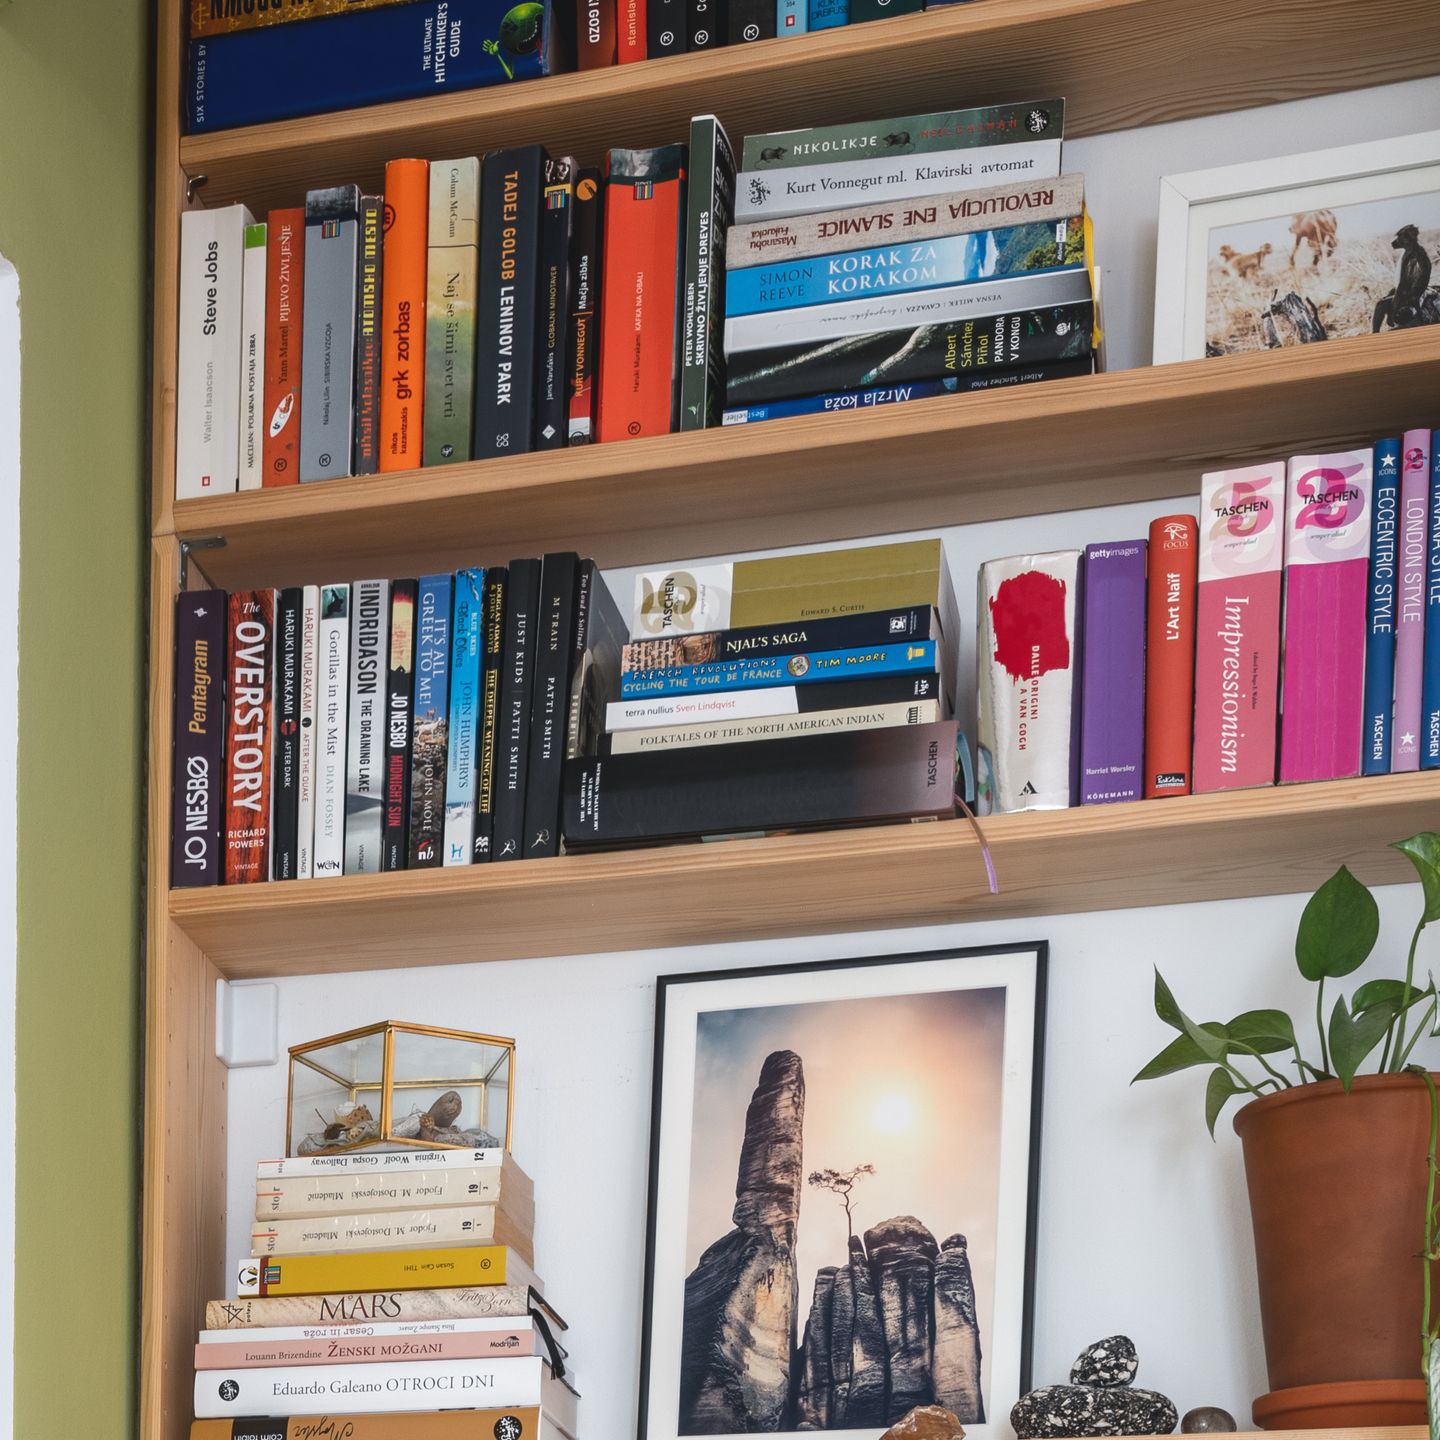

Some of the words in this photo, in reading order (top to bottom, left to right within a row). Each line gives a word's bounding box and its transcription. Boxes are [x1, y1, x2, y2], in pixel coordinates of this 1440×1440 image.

[198, 44, 207, 56] BY
[435, 1, 449, 83] HITCHHIKER'S
[449, 20, 461, 57] GUIDE
[196, 59, 206, 104] STORIES
[197, 107, 205, 123] SIX
[793, 136, 878, 155] NIKOLIKJE
[786, 180, 816, 195] Kurt
[818, 175, 883, 194] Vonnegut
[887, 172, 907, 184] ml.
[916, 164, 972, 181] Klavirski
[981, 158, 1034, 175] avtomat
[504, 171, 519, 222] TADEJ
[948, 190, 1054, 219] REVOLUCIJA
[818, 213, 893, 239] SLAMICE
[903, 210, 936, 226] ENE
[203, 241, 218, 286] Jobs
[501, 227, 516, 280] GOLOB
[828, 250, 902, 275] KORAK
[910, 246, 936, 261] ZA
[759, 266, 813, 286] SIMON
[828, 267, 938, 295] KORAKOM
[760, 285, 805, 302] REEVE
[203, 292, 217, 336] Steve
[499, 286, 515, 357] LENINOV
[393, 301, 411, 362] zorbas
[391, 369, 410, 399] grk
[497, 361, 511, 405] PARK
[1215, 500, 1269, 518] TASCHEN
[1302, 489, 1359, 506] TASCHEN
[1375, 487, 1395, 578] ECCENTRIC
[1090, 546, 1139, 559] gettyimages
[662, 577, 674, 628] TASCHEN
[1168, 572, 1181, 606] Naïf
[242, 601, 261, 615] The
[1373, 581, 1392, 634] STYLE
[285, 609, 295, 655] HARUKI
[1167, 610, 1181, 640] L'Art
[329, 630, 340, 680] Gorillas
[726, 637, 770, 652] NJAL'S
[773, 632, 808, 646] SAGA
[189, 640, 213, 734] Pentagram
[283, 658, 294, 714] MURAKAMI
[328, 685, 336, 694] in
[392, 692, 407, 706] JO
[1220, 596, 1249, 774] Impressionism
[234, 621, 265, 812] OVERSTORY
[328, 697, 337, 723] the
[625, 708, 645, 717] terra
[647, 704, 674, 715] nullius
[675, 703, 696, 712] Sven
[697, 699, 735, 711] Lindqvist
[327, 728, 337, 757] Mist
[390, 710, 407, 749] NESBO
[640, 730, 701, 746] FOLKTALES
[704, 729, 717, 738] OF
[720, 726, 743, 738] THE
[746, 722, 784, 735] NORTH
[787, 718, 843, 733] AMERICAN
[846, 713, 885, 726] INDIAN
[186, 756, 208, 832] NESBØ
[1087, 790, 1134, 800] KÖNEMANN
[228, 826, 266, 839] RICHARD
[229, 838, 264, 849] POWERS
[185, 836, 207, 870] JO
[319, 1292, 402, 1321] MARS
[327, 1341, 376, 1358] ŽENSKI
[380, 1342, 443, 1355] MOŽGANI
[273, 1382, 326, 1396] Eduardo
[330, 1380, 381, 1394] Galeano
[386, 1377, 454, 1392] OTROCI
[459, 1375, 494, 1389] DNI
